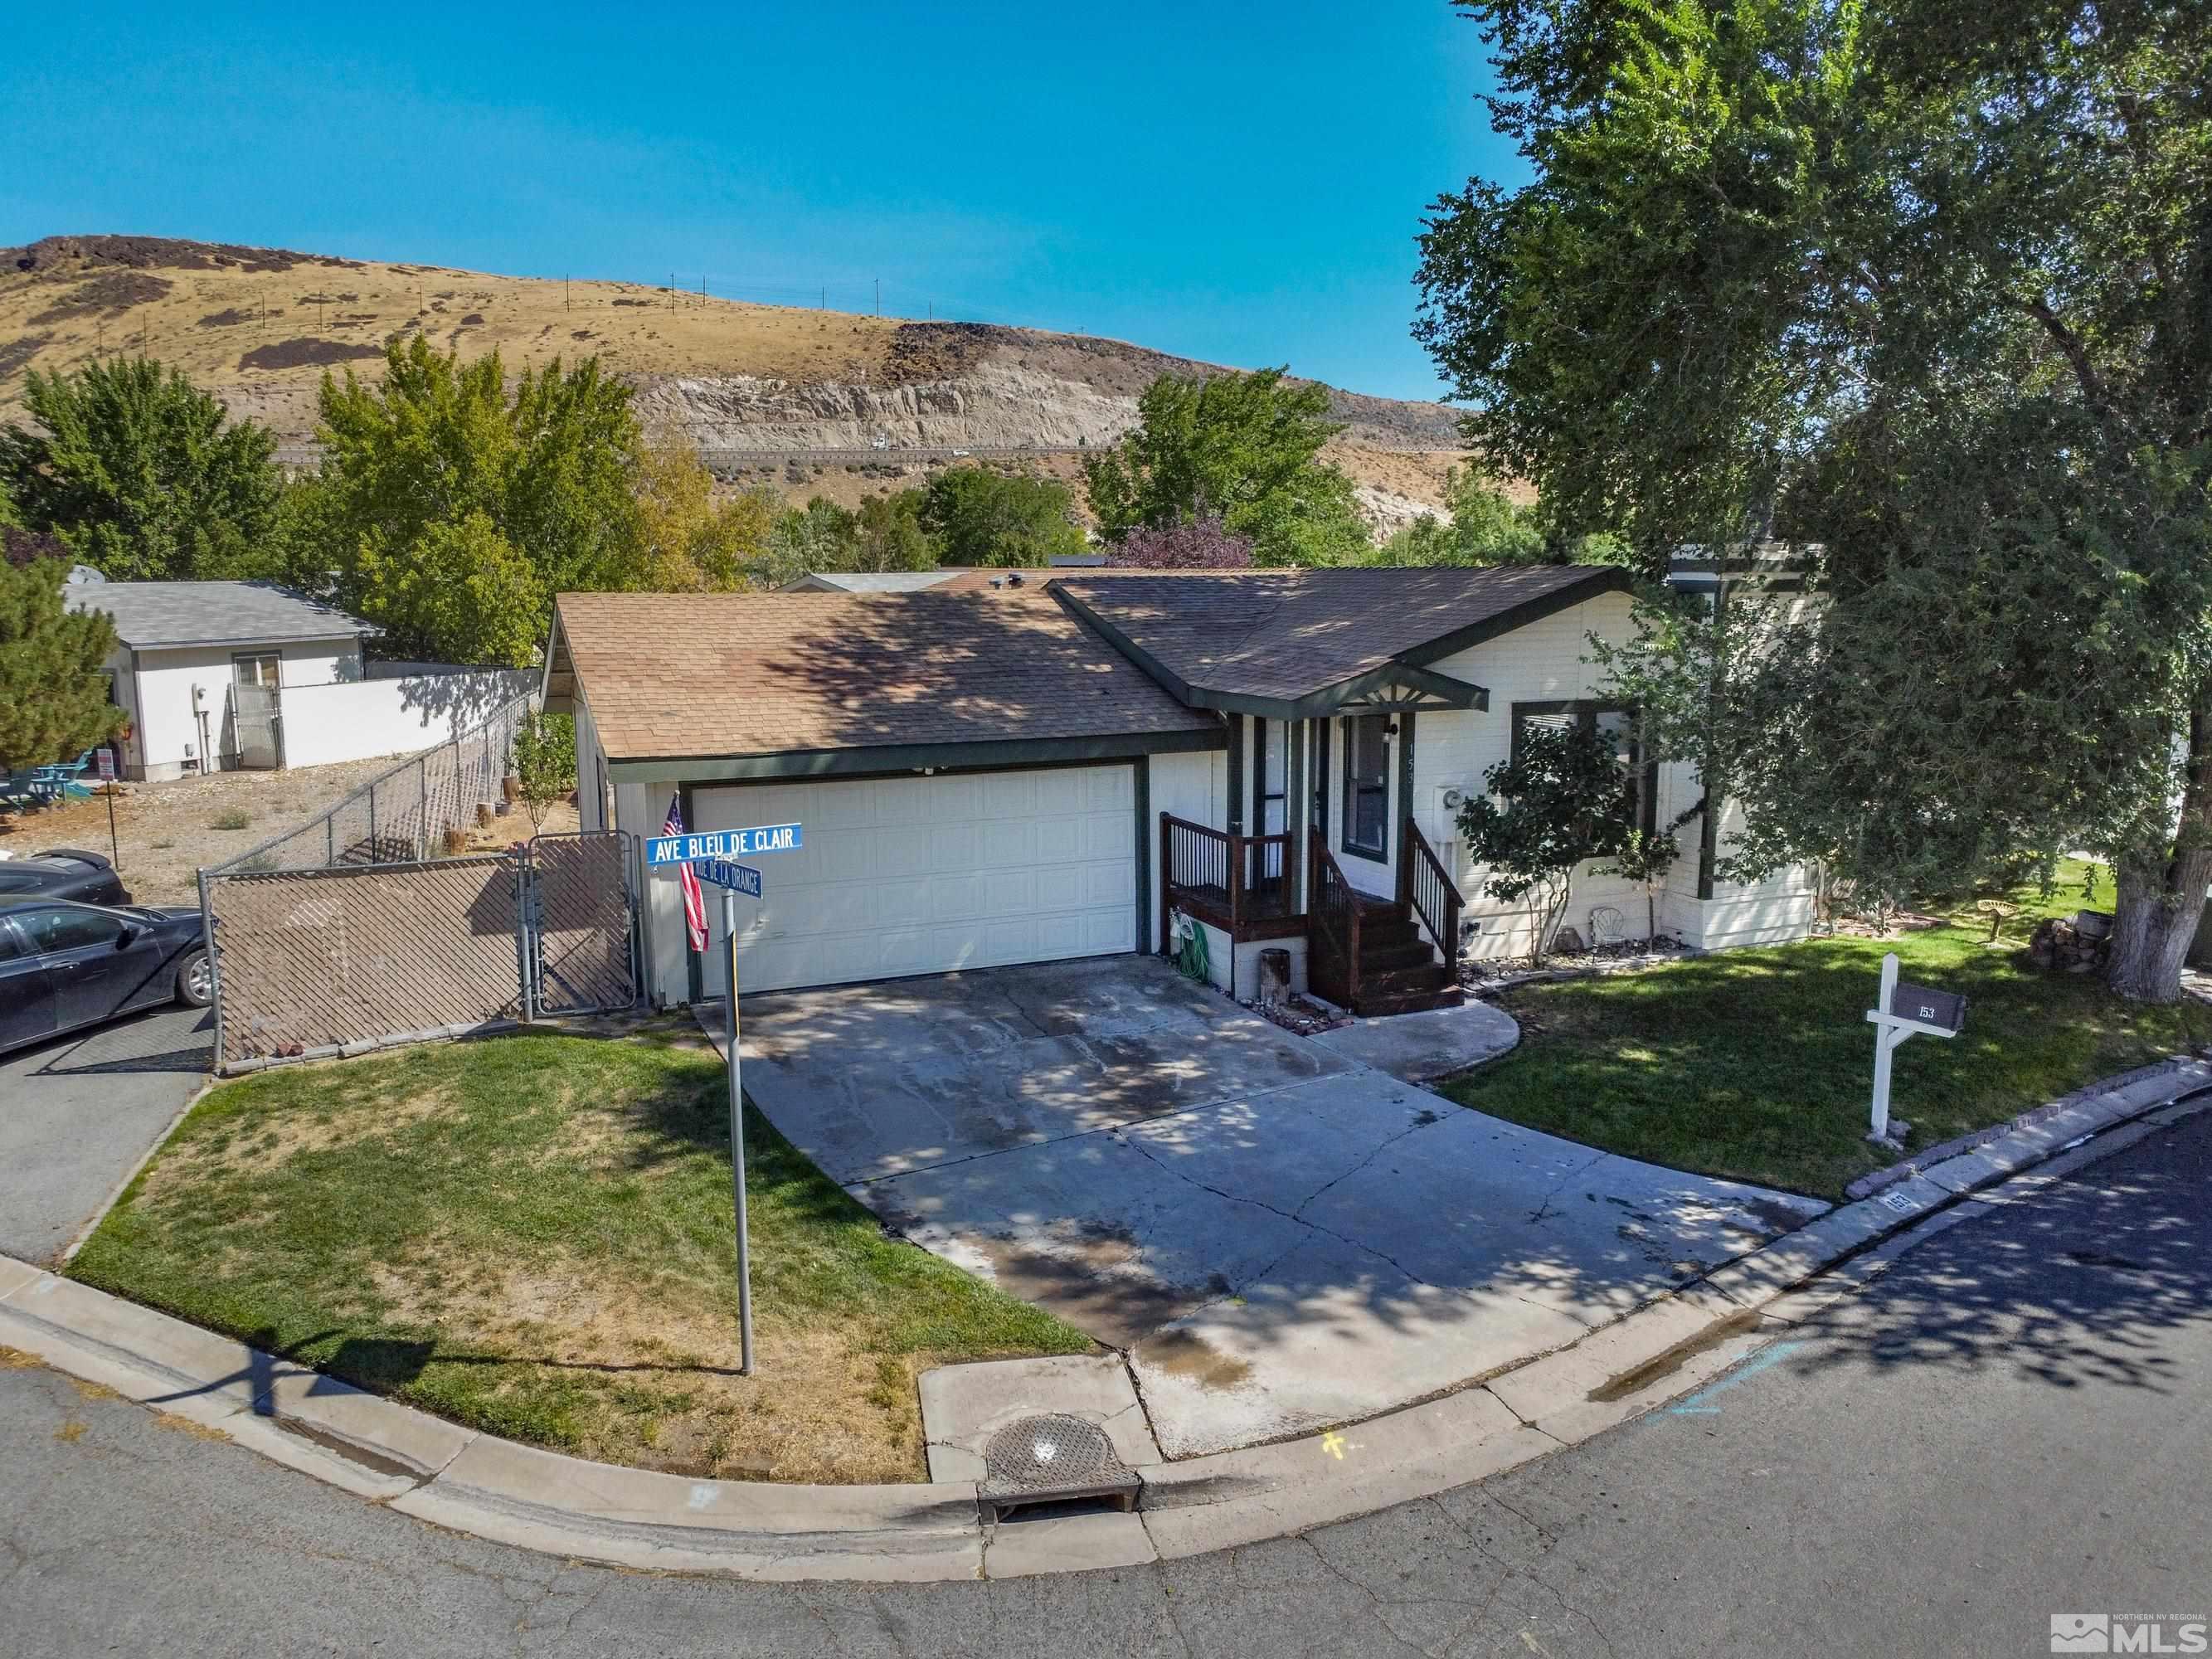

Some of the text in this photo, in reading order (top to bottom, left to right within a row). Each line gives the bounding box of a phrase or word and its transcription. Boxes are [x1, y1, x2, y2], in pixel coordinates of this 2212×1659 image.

[655, 828, 794, 862] AVE BLEU DE CLAIR
[710, 861, 718, 881] DE
[720, 864, 730, 884] LA
[732, 868, 758, 893] ORANGE
[1919, 1006, 1935, 1019] 153
[1886, 1194, 1911, 1210] 153
